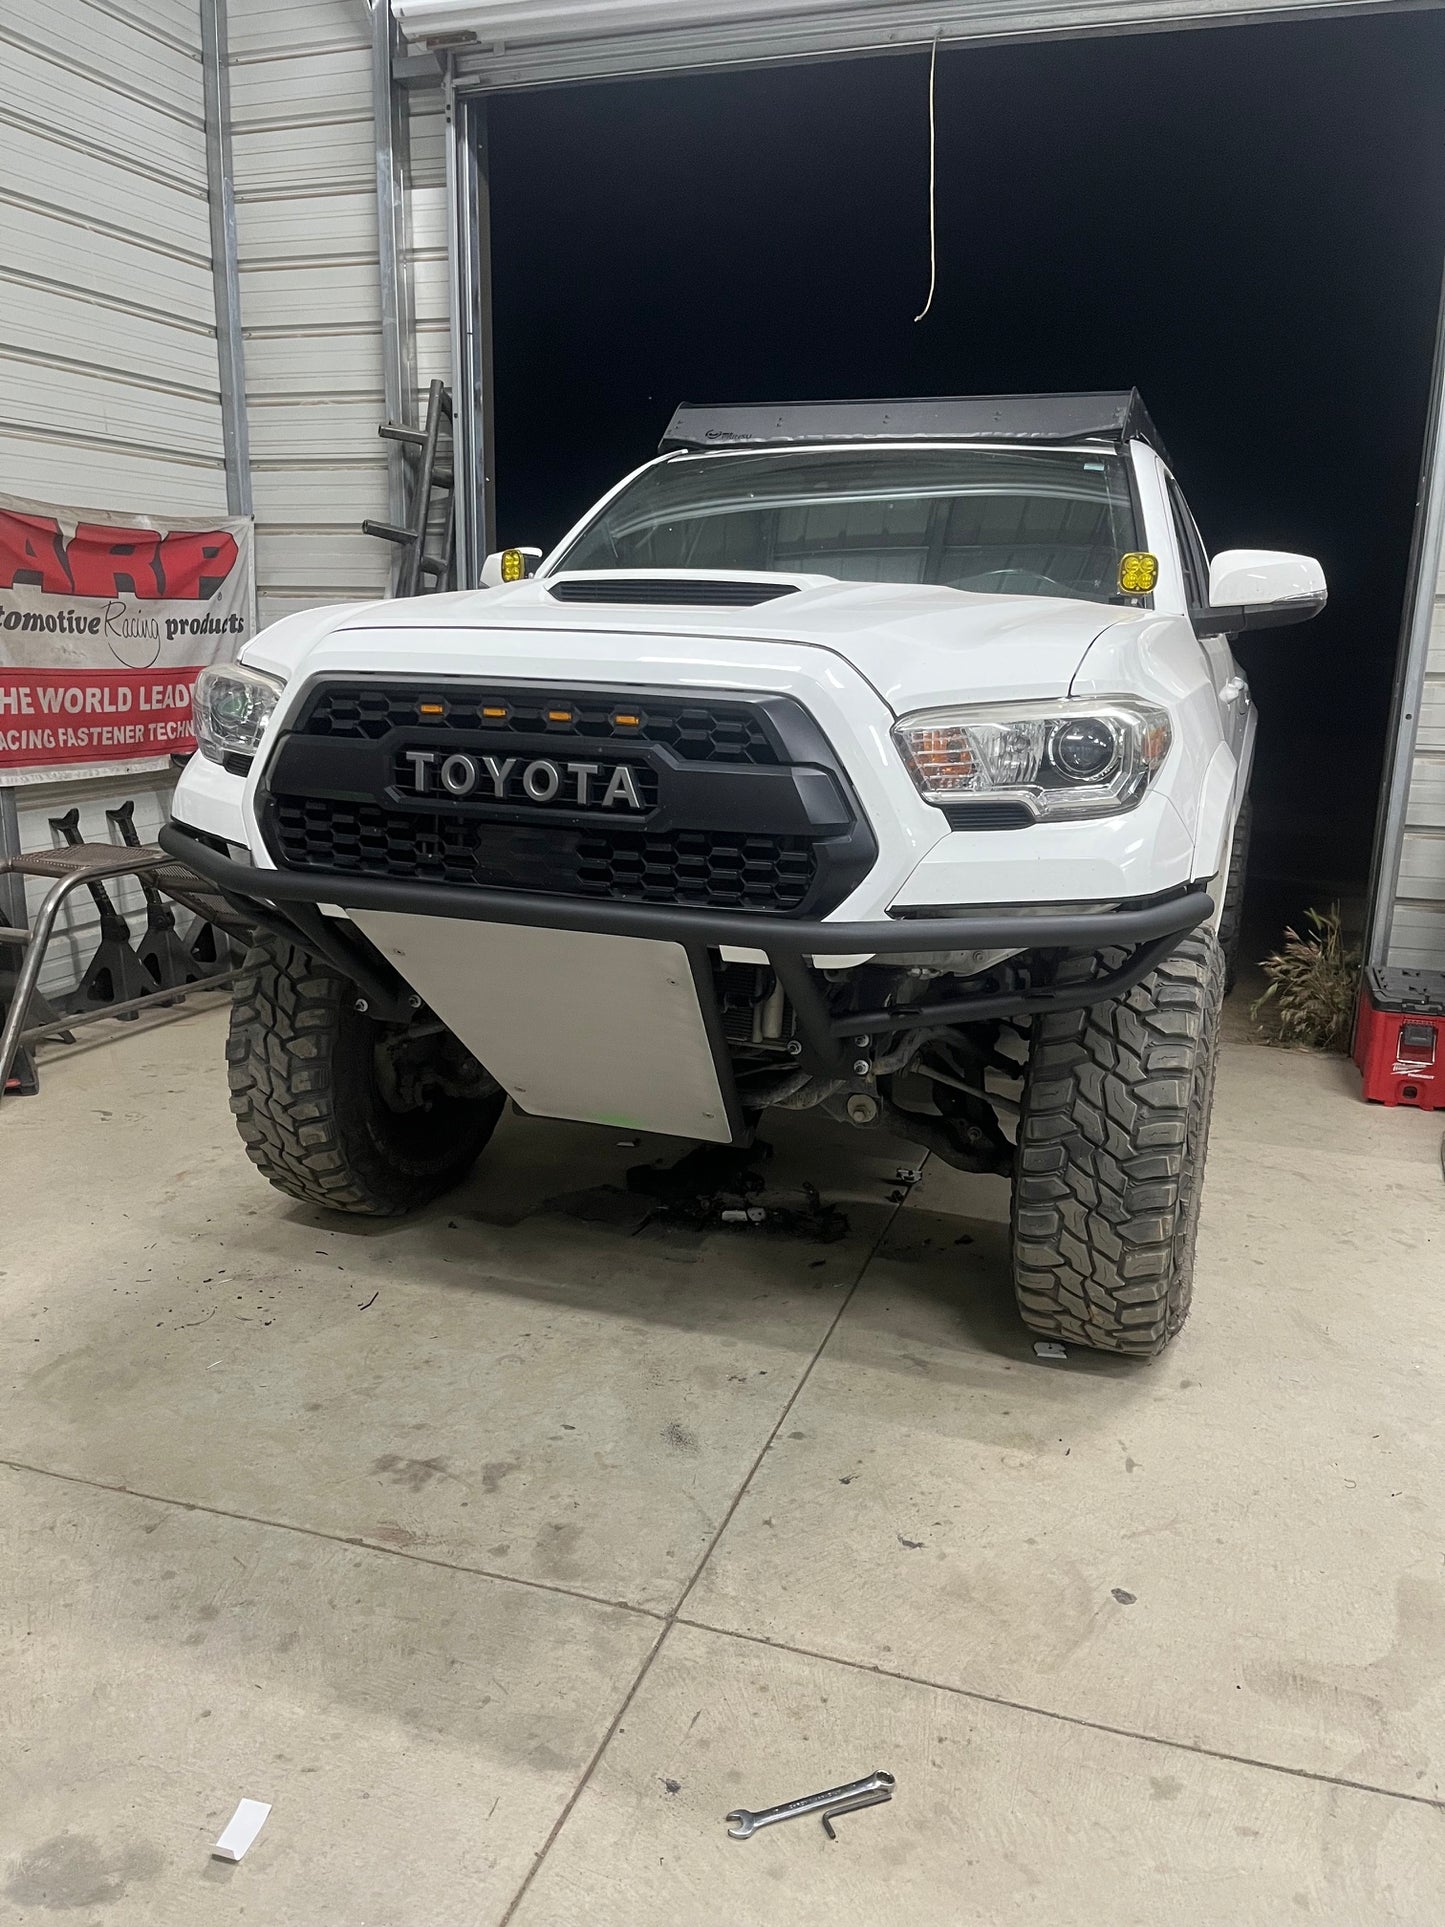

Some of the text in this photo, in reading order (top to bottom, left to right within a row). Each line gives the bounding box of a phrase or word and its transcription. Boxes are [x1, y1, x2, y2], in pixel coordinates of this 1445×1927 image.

[0, 508, 239, 600] ARP
[101, 600, 161, 669] Racing
[165, 612, 244, 640] products
[0, 687, 35, 715] HE
[37, 686, 132, 714] WORLD
[58, 724, 144, 747] FASTENER
[405, 751, 642, 809] TOYOTA
